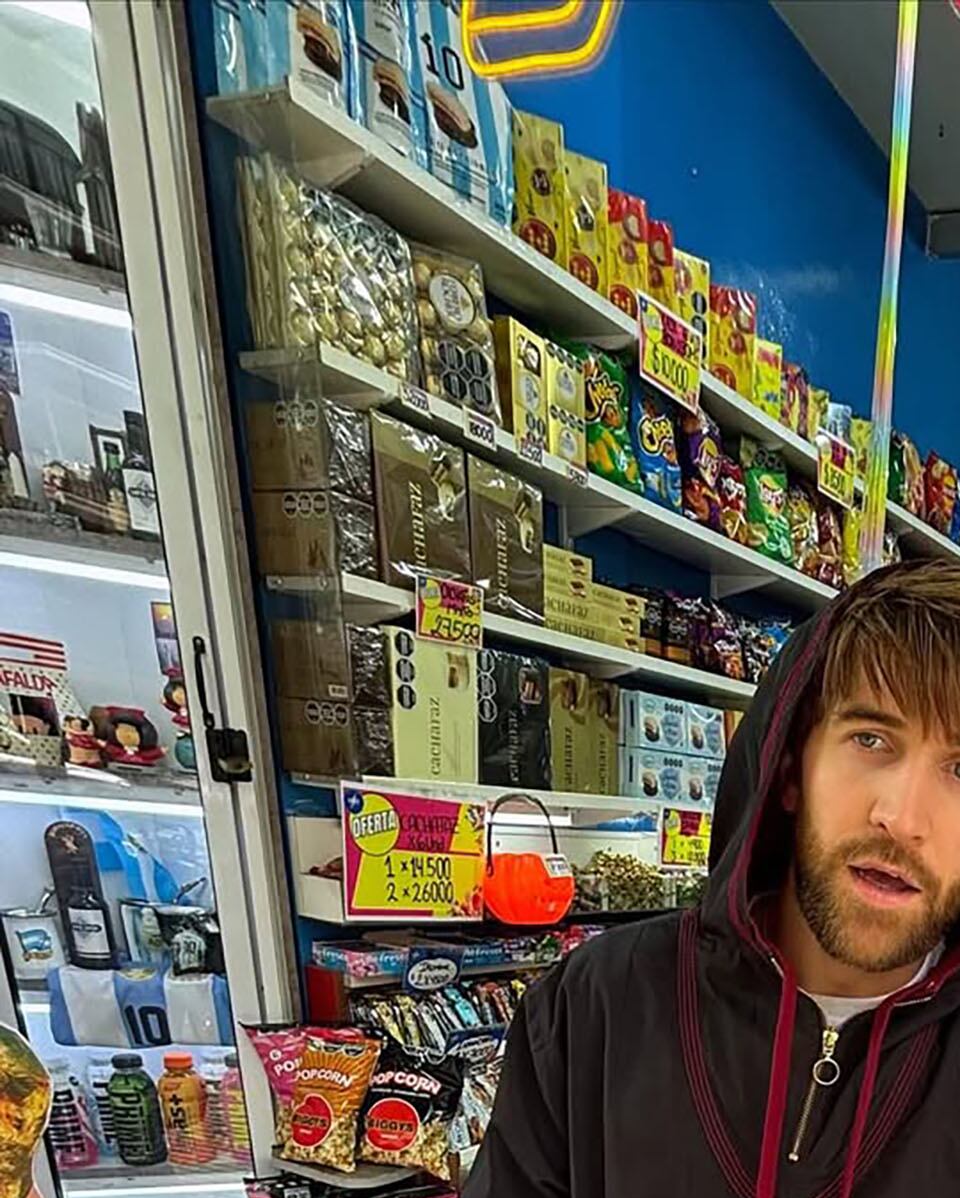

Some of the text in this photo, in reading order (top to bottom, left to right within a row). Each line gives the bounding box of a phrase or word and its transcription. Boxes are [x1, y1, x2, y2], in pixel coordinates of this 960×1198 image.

[420, 32, 465, 91] 10
[0, 670, 58, 691] FALDA
[353, 810, 397, 838] OFERTA
[384, 856, 396, 878] 1
[386, 882, 398, 902] 2
[124, 1004, 172, 1046] 10
